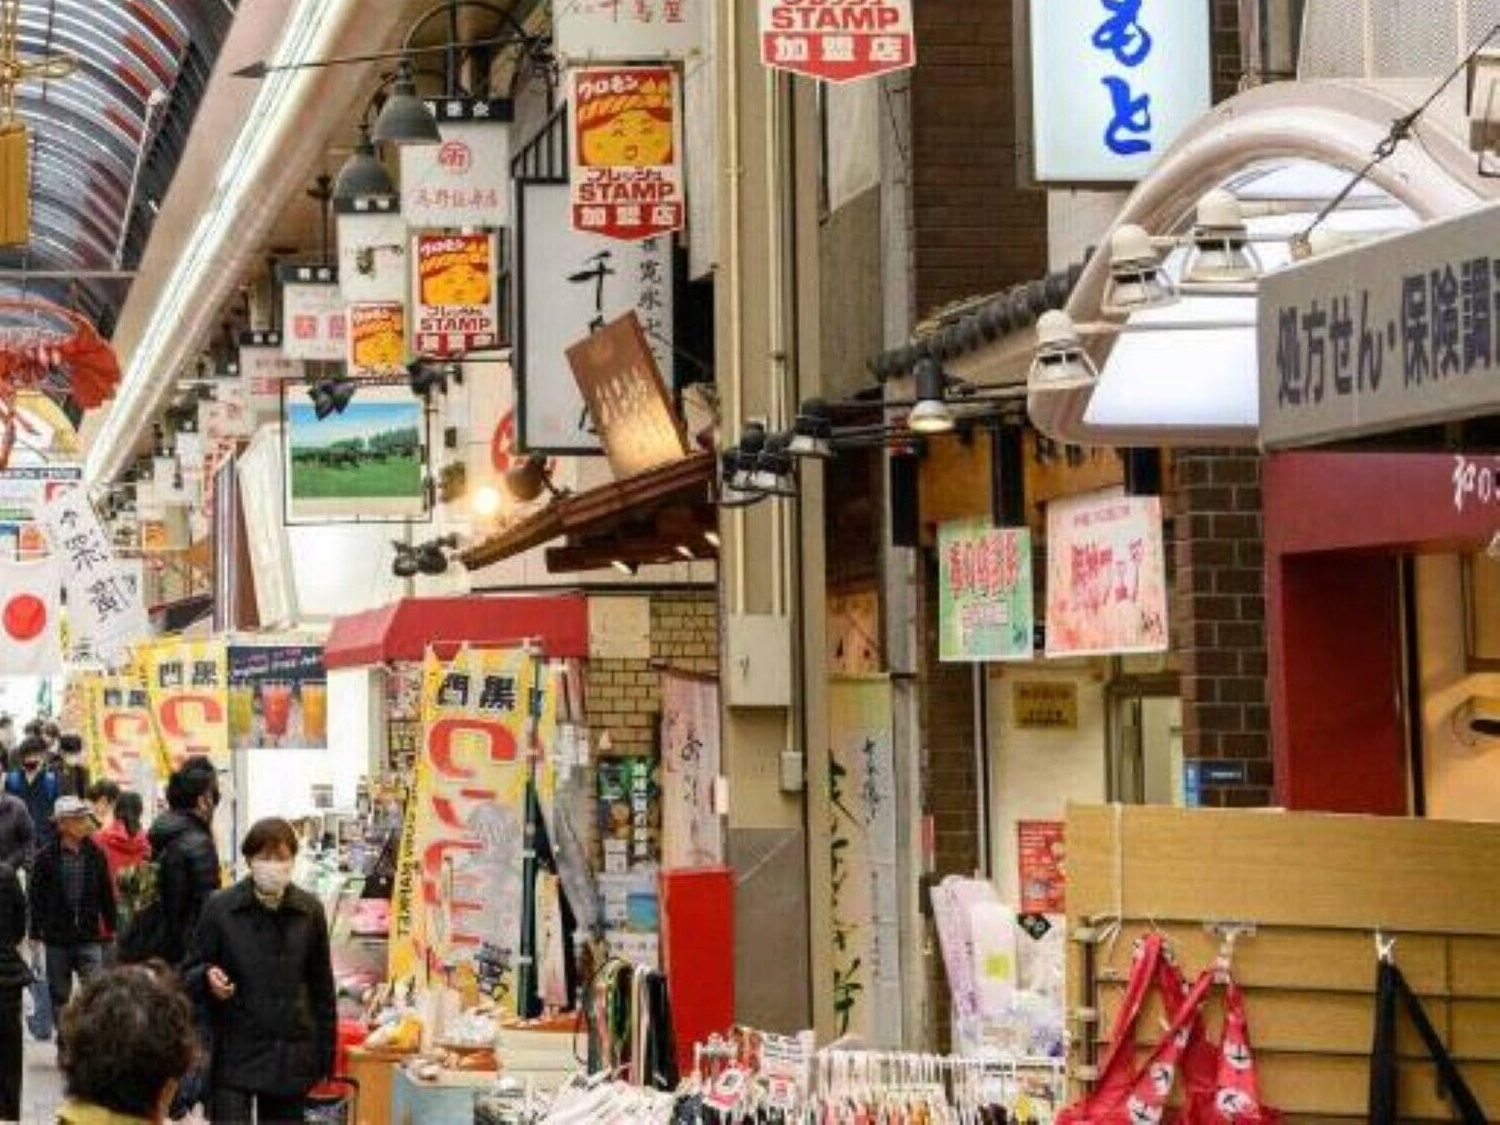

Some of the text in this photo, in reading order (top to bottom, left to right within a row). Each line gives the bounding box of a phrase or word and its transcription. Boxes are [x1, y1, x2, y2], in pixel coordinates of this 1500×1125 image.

[771, 7, 900, 30] STAMP
[774, 36, 902, 62] 加盟店
[578, 182, 675, 202] STAMP
[420, 317, 492, 331] STAMP
[1277, 256, 1500, 409] 処方せん・保険調
[1452, 454, 1500, 513] 和の
